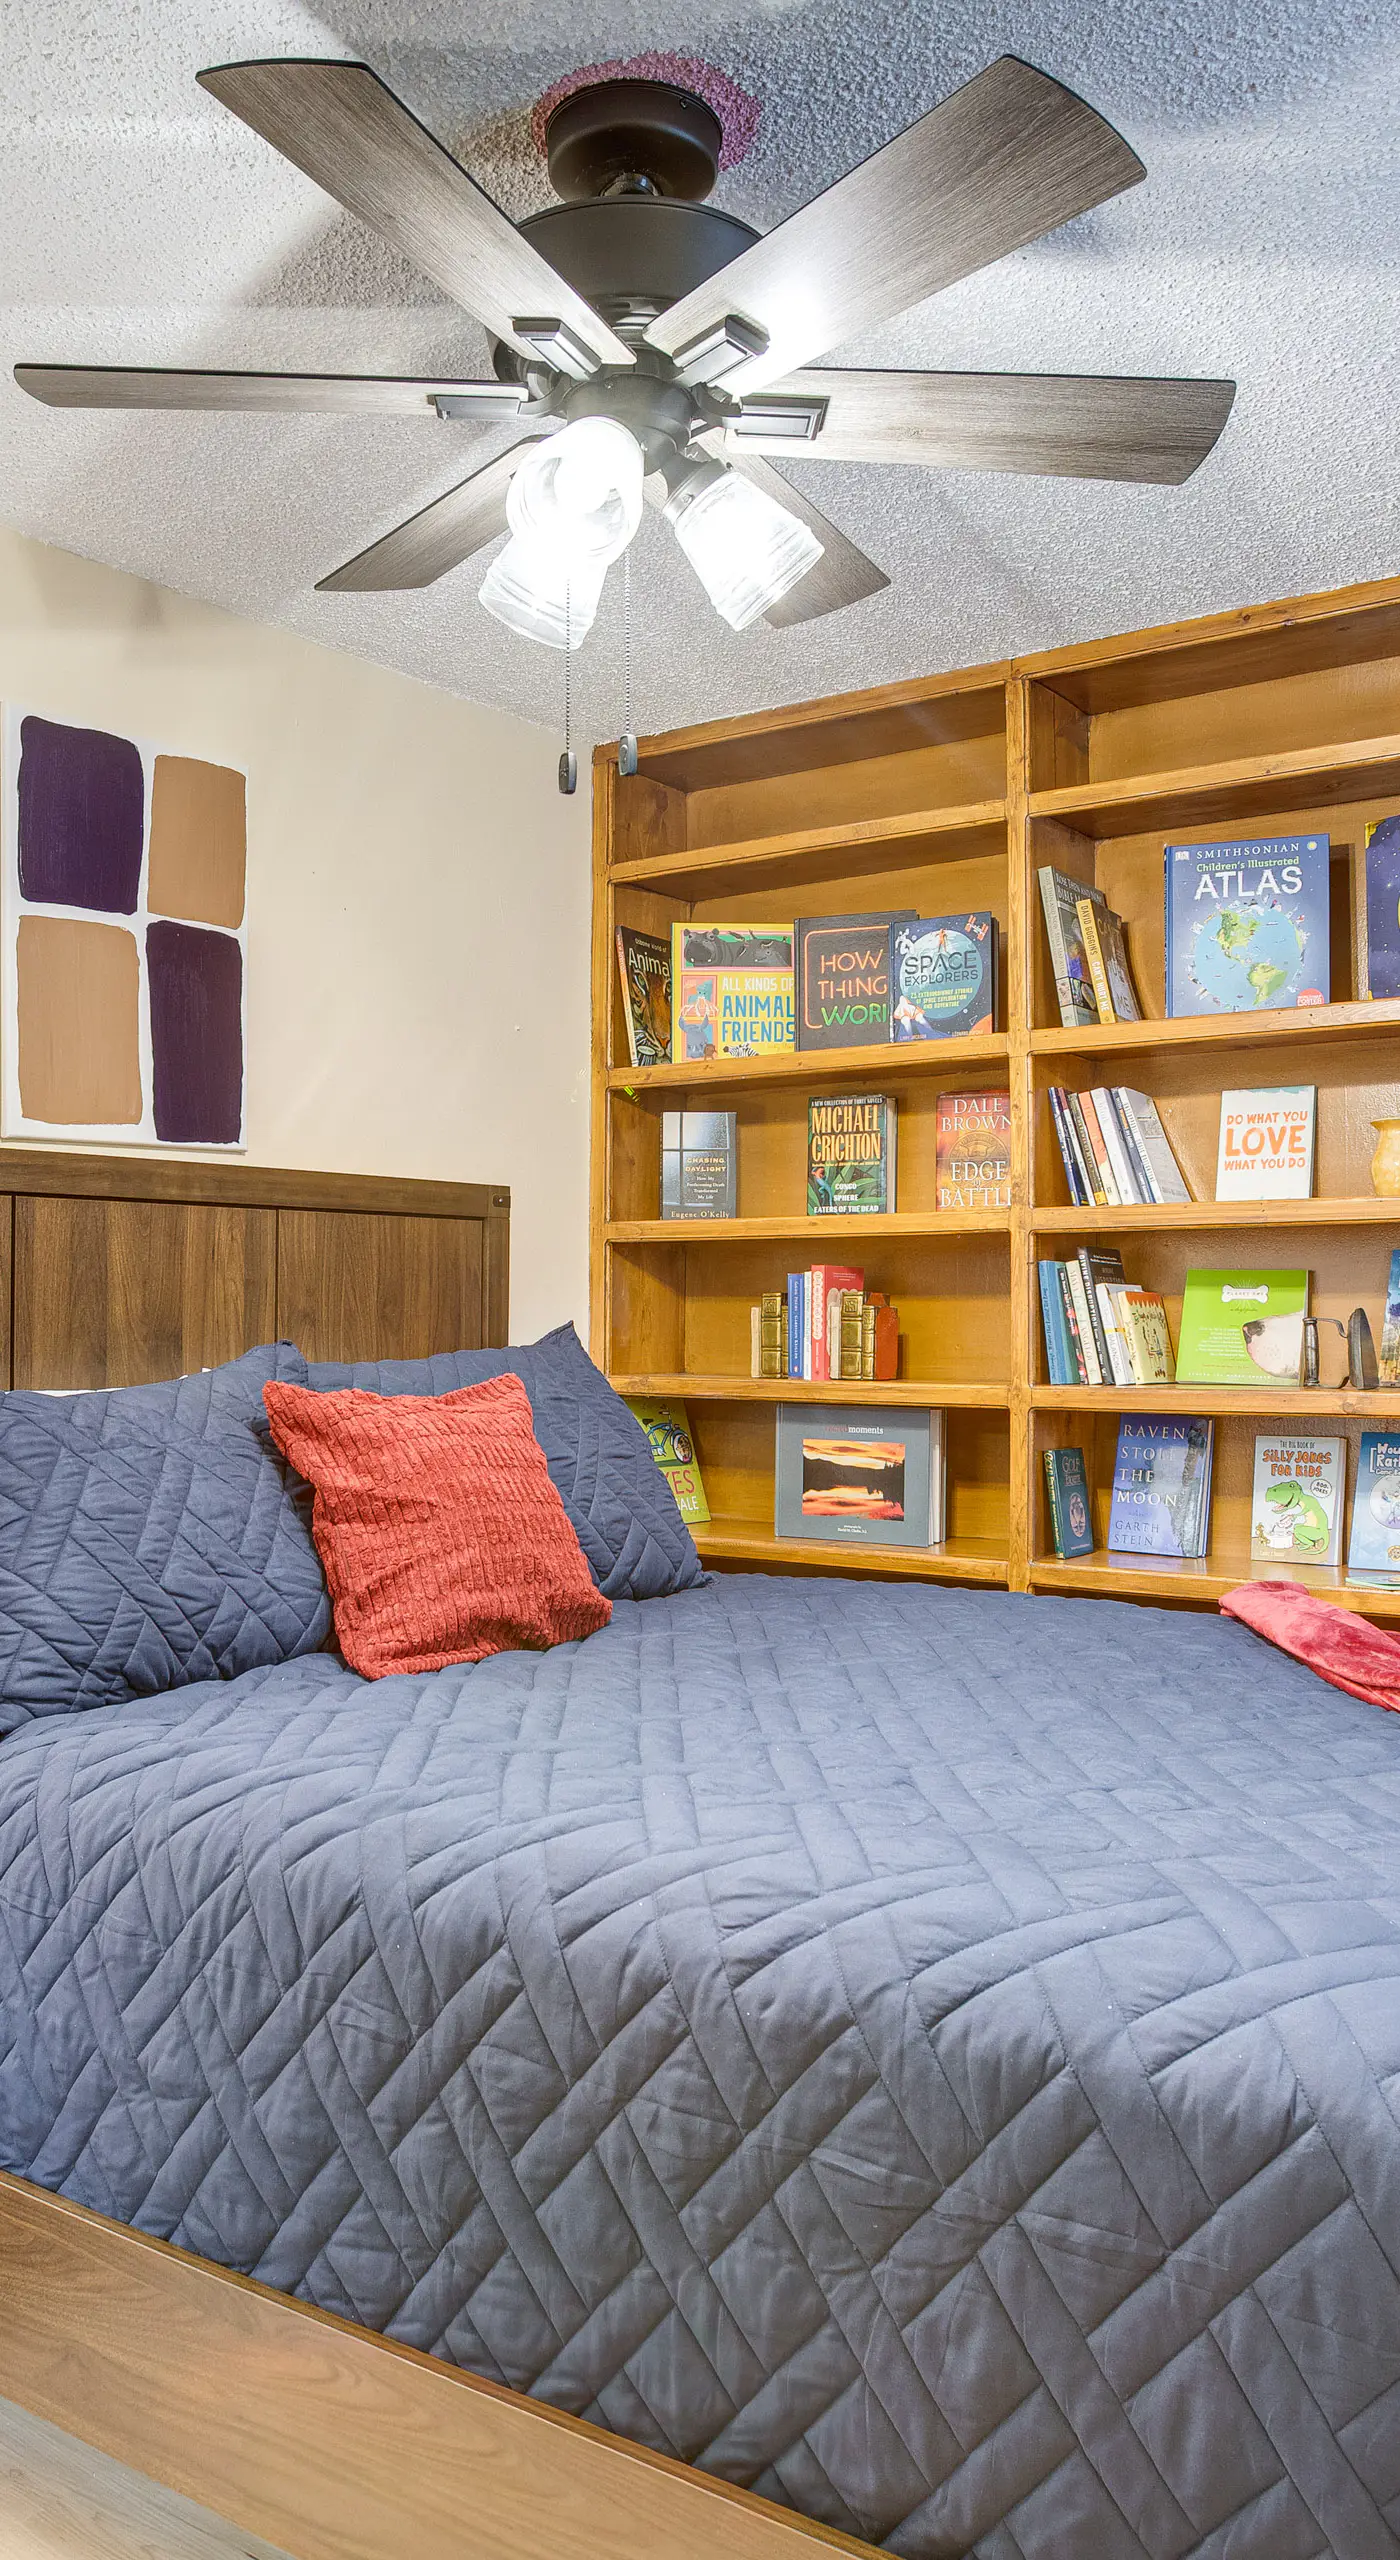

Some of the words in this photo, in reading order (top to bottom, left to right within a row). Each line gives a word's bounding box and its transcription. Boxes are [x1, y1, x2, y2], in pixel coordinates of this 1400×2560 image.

[1196, 842, 1300, 859] SMITHSONIAN
[1196, 860, 1245, 873] Children's
[1248, 856, 1300, 868] Illustrated
[1055, 872, 1069, 887] ROSE
[1194, 866, 1303, 900] ATLAS
[1056, 885, 1073, 904] BIBLE
[1081, 905, 1092, 924] DAVID
[1085, 926, 1098, 956] GOGGINS
[628, 948, 671, 977] Anima
[821, 949, 885, 974] HOW
[904, 950, 978, 975] SPACE
[904, 968, 979, 987] EXPLORERS
[1092, 961, 1104, 980] CAN'T
[722, 976, 740, 991] ALL
[744, 977, 778, 991] KINDS
[781, 978, 794, 990] OF
[1096, 983, 1108, 999] HURT
[722, 995, 795, 1018] ANIMAL
[1100, 1000, 1110, 1012] ME
[722, 1020, 795, 1042] FRIENDS
[954, 1098, 1003, 1114] DALE
[812, 1105, 880, 1133] MICHAEL
[1227, 1114, 1243, 1125] DO
[1247, 1112, 1279, 1124] WHAT
[1283, 1111, 1308, 1122] YOU
[812, 1133, 880, 1162] CRICHTON
[1225, 1125, 1306, 1157] LOVE
[951, 1161, 1006, 1182] EDGE
[1224, 1160, 1256, 1171] WHAT
[1261, 1158, 1285, 1169] YOU
[1288, 1157, 1305, 1168] DO
[834, 1194, 858, 1202] SPHERE
[671, 1211, 697, 1219] Eugene
[700, 1210, 730, 1219] O'Kelly
[1079, 1254, 1089, 1280] DIVINE
[1085, 1281, 1098, 1327] DISRUPTION
[848, 1426, 884, 1435] moments
[1124, 1424, 1185, 1440] RAVEN
[1121, 1446, 1175, 1460] STOLE
[1297, 1441, 1308, 1449] BOOK
[1309, 1441, 1316, 1449] OF
[1294, 1451, 1332, 1464] JOKES
[1376, 1454, 1400, 1467] Rat
[1119, 1468, 1153, 1482] THE
[1271, 1464, 1292, 1476] FOR
[1295, 1465, 1322, 1477] KiDS
[1117, 1490, 1177, 1506] MOON
[1312, 1487, 1328, 1495] JOKES
[1115, 1520, 1159, 1533] GARTH
[1114, 1534, 1153, 1546] STEIN
